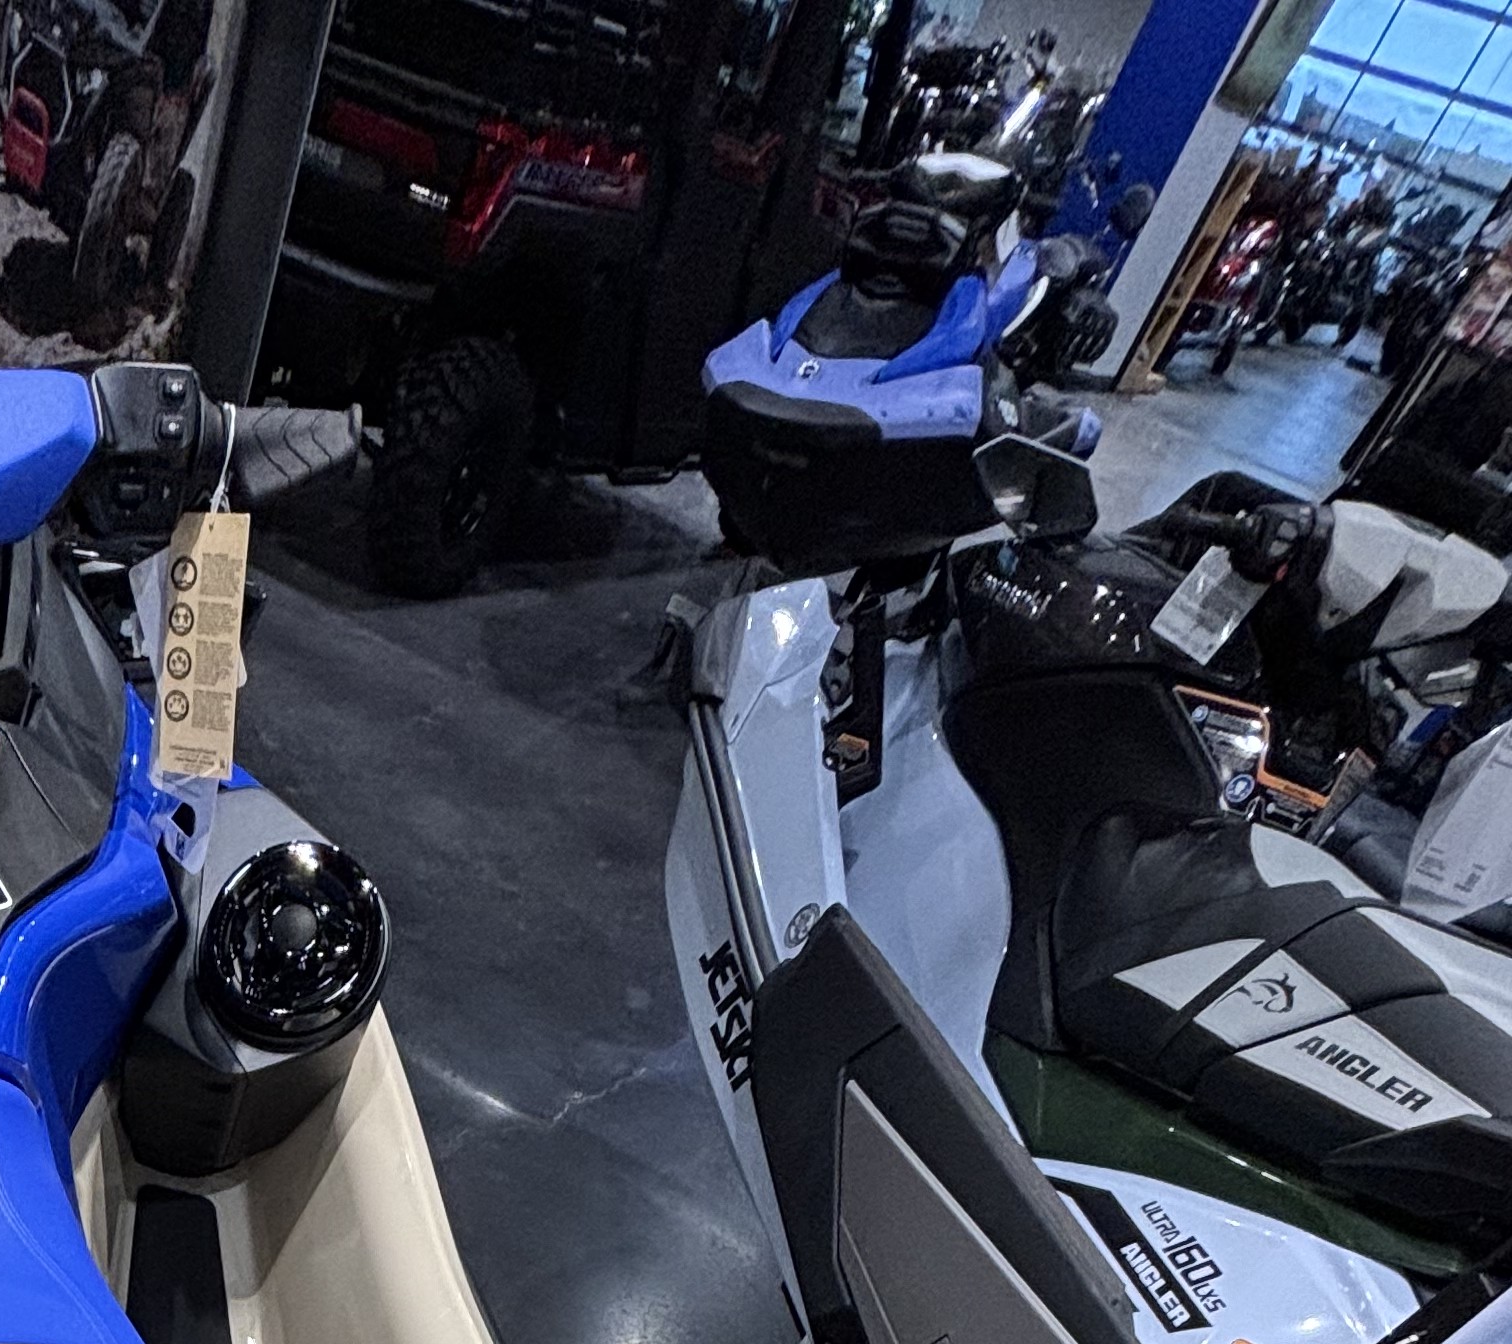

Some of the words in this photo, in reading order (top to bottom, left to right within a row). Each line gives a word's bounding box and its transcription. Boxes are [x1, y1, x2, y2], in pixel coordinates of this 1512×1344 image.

[1294, 1035, 1433, 1113] ANGLER
[1141, 1201, 1181, 1243] ULTRA
[1119, 1242, 1191, 1328] ANGLER
